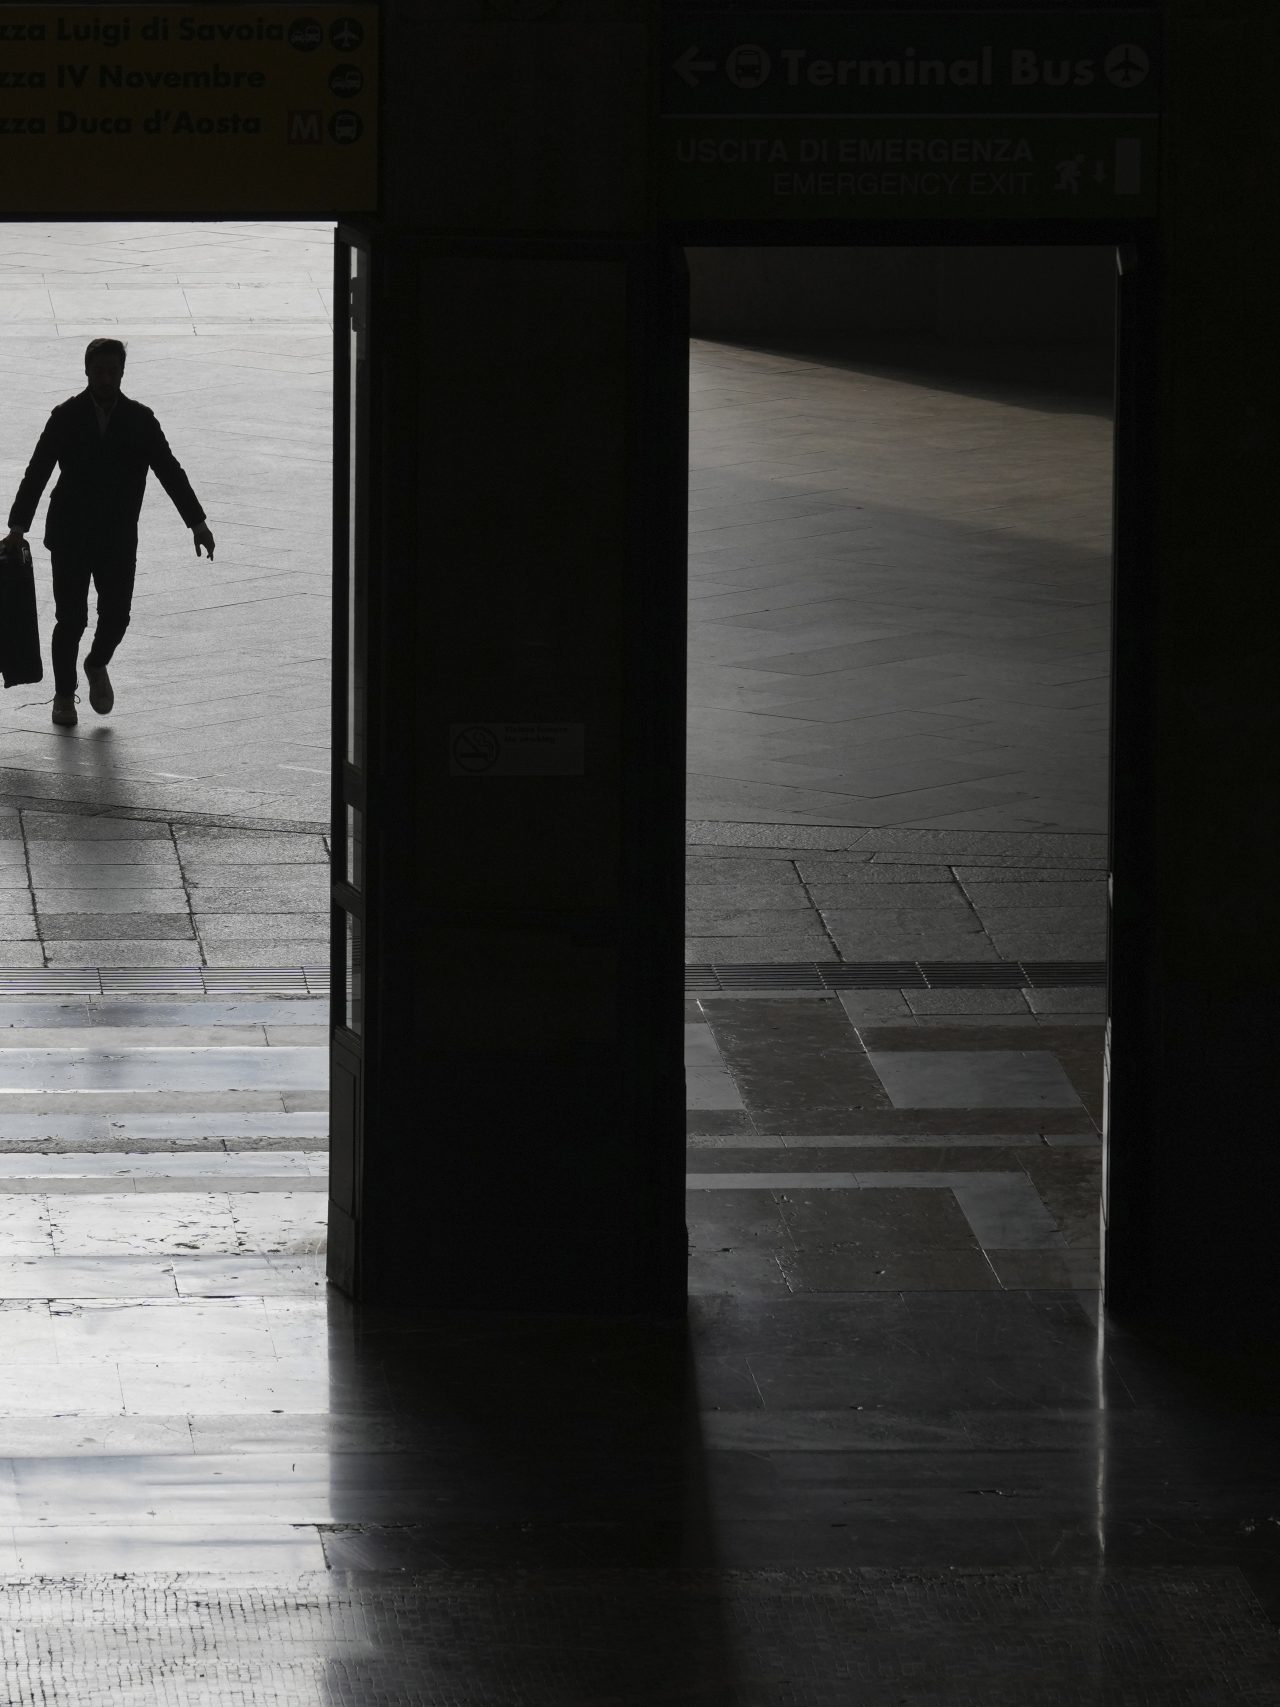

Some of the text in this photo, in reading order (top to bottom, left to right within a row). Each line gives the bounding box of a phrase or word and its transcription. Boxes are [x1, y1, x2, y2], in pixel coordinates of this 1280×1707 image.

[57, 17, 130, 46] Luigi
[141, 17, 169, 42] di
[179, 18, 284, 42] Savoia
[57, 65, 89, 88] IV
[100, 64, 265, 89] Novembre
[781, 46, 1095, 88] Terminal Bus
[57, 111, 132, 135] Duca
[143, 110, 261, 135] d'Aosta
[676, 139, 1033, 164] USCITA DI EMERGENZA
[773, 172, 1033, 196] EMERGENCY EXIT
